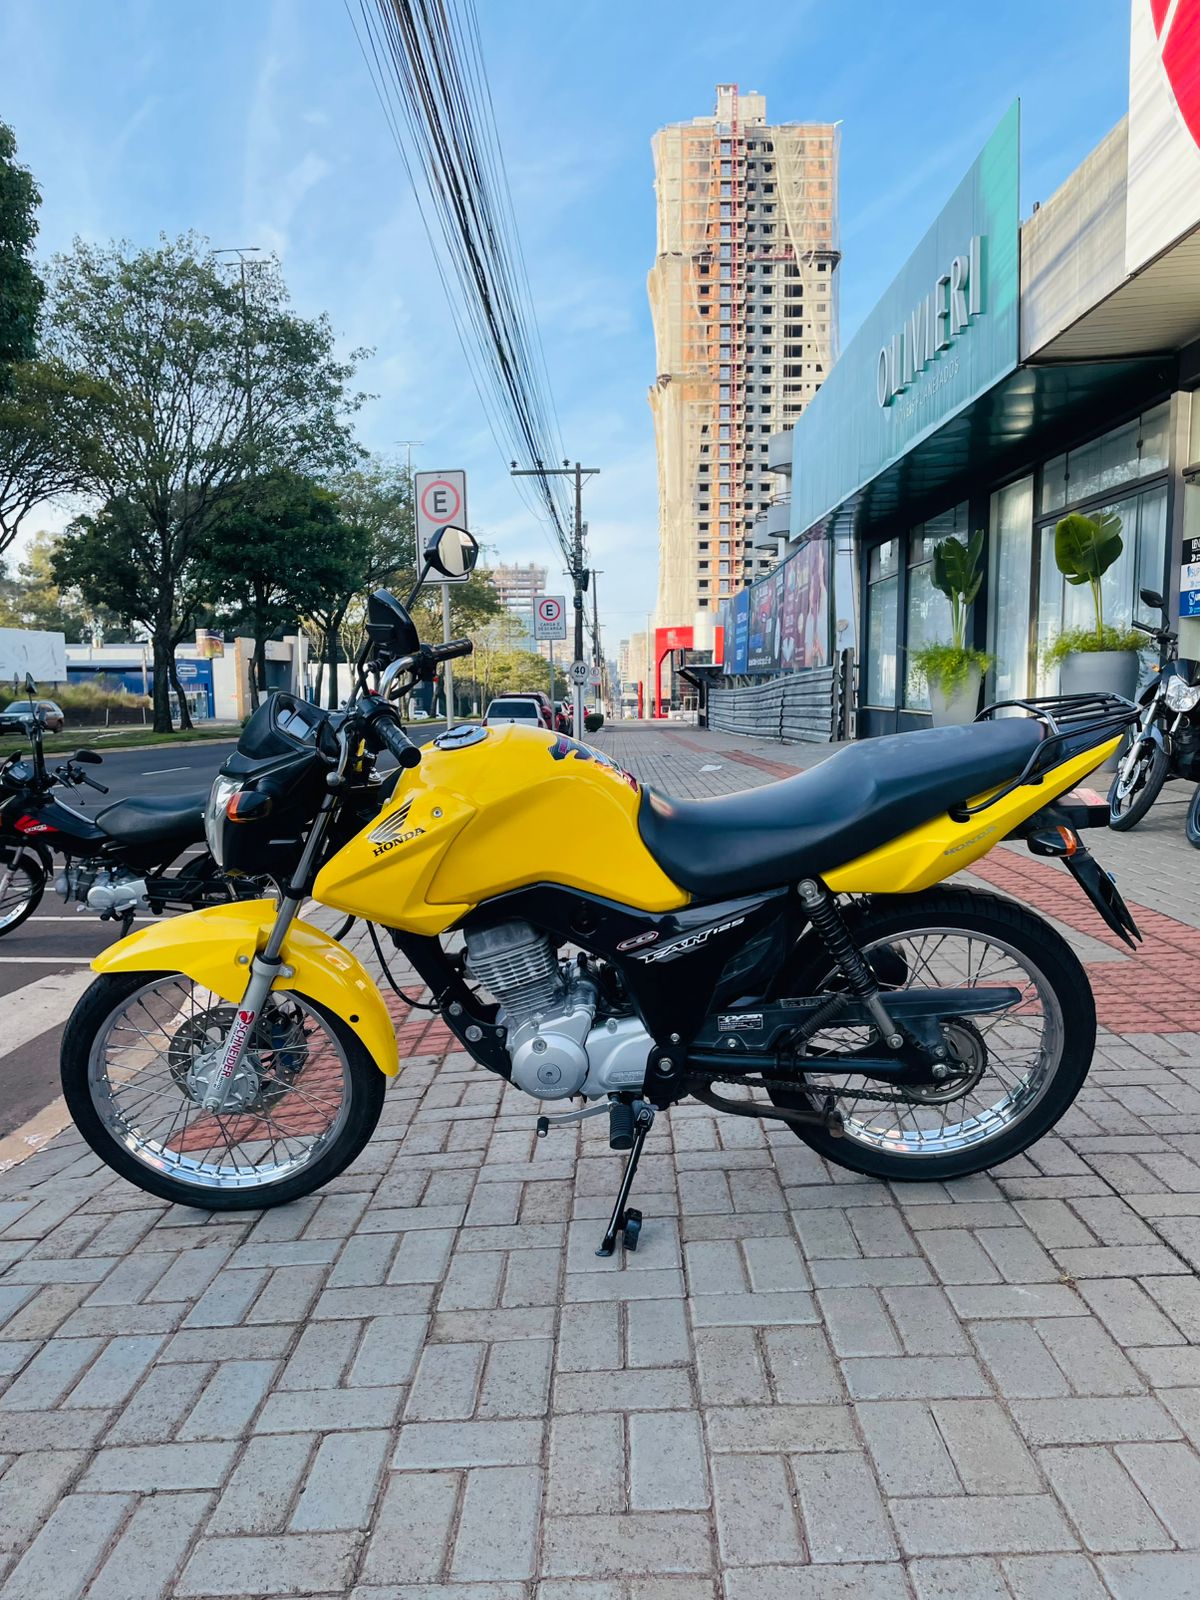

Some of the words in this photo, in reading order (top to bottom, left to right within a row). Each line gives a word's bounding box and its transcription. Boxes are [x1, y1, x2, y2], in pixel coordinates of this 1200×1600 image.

[877, 235, 982, 408] OLIVIERI
[433, 490, 447, 513] E
[546, 604, 554, 616] E
[574, 666, 585, 674] 40
[373, 827, 426, 857] HONDA
[637, 928, 714, 964] FAN
[223, 1023, 249, 1078] SCHNEIDER
